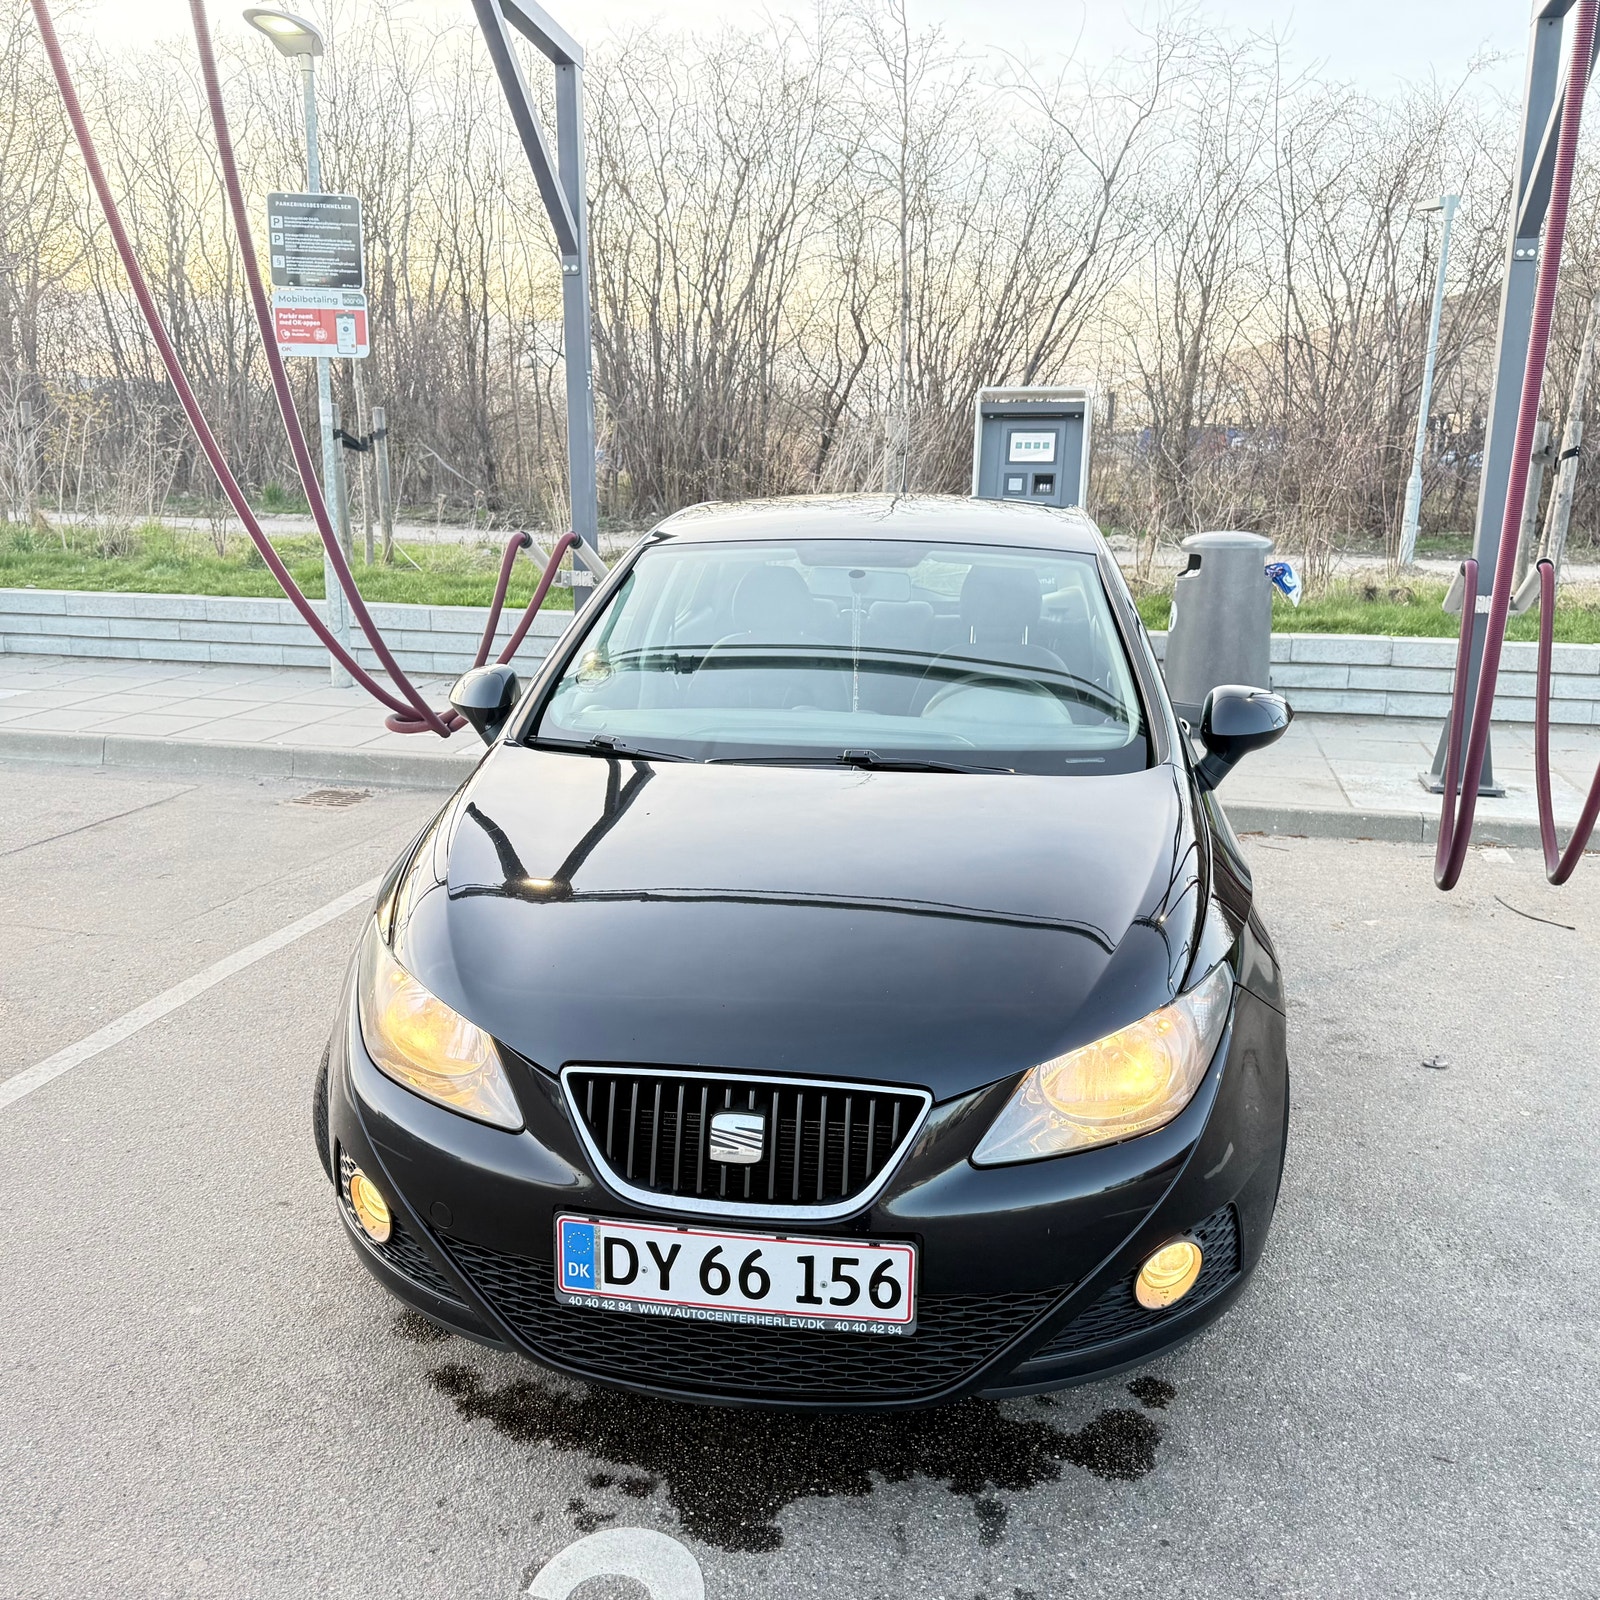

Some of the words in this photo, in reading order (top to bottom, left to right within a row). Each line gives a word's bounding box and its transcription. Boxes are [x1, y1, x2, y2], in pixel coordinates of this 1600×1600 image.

[273, 218, 280, 226] P
[274, 235, 281, 243] P
[278, 295, 338, 305] Mobilbetaling
[568, 1262, 590, 1279] DK
[604, 1236, 682, 1291] DY
[699, 1245, 771, 1300] 66
[796, 1255, 902, 1310] 156
[568, 1296, 582, 1306] 40
[585, 1297, 599, 1308] 40
[602, 1300, 616, 1310] 42
[618, 1301, 632, 1312] 94
[638, 1303, 825, 1330] WWW.AUTOCENTERHERLEV.DK
[834, 1321, 849, 1331] 40
[852, 1322, 867, 1333] 40
[869, 1324, 885, 1334] 42
[887, 1325, 902, 1335] 94
